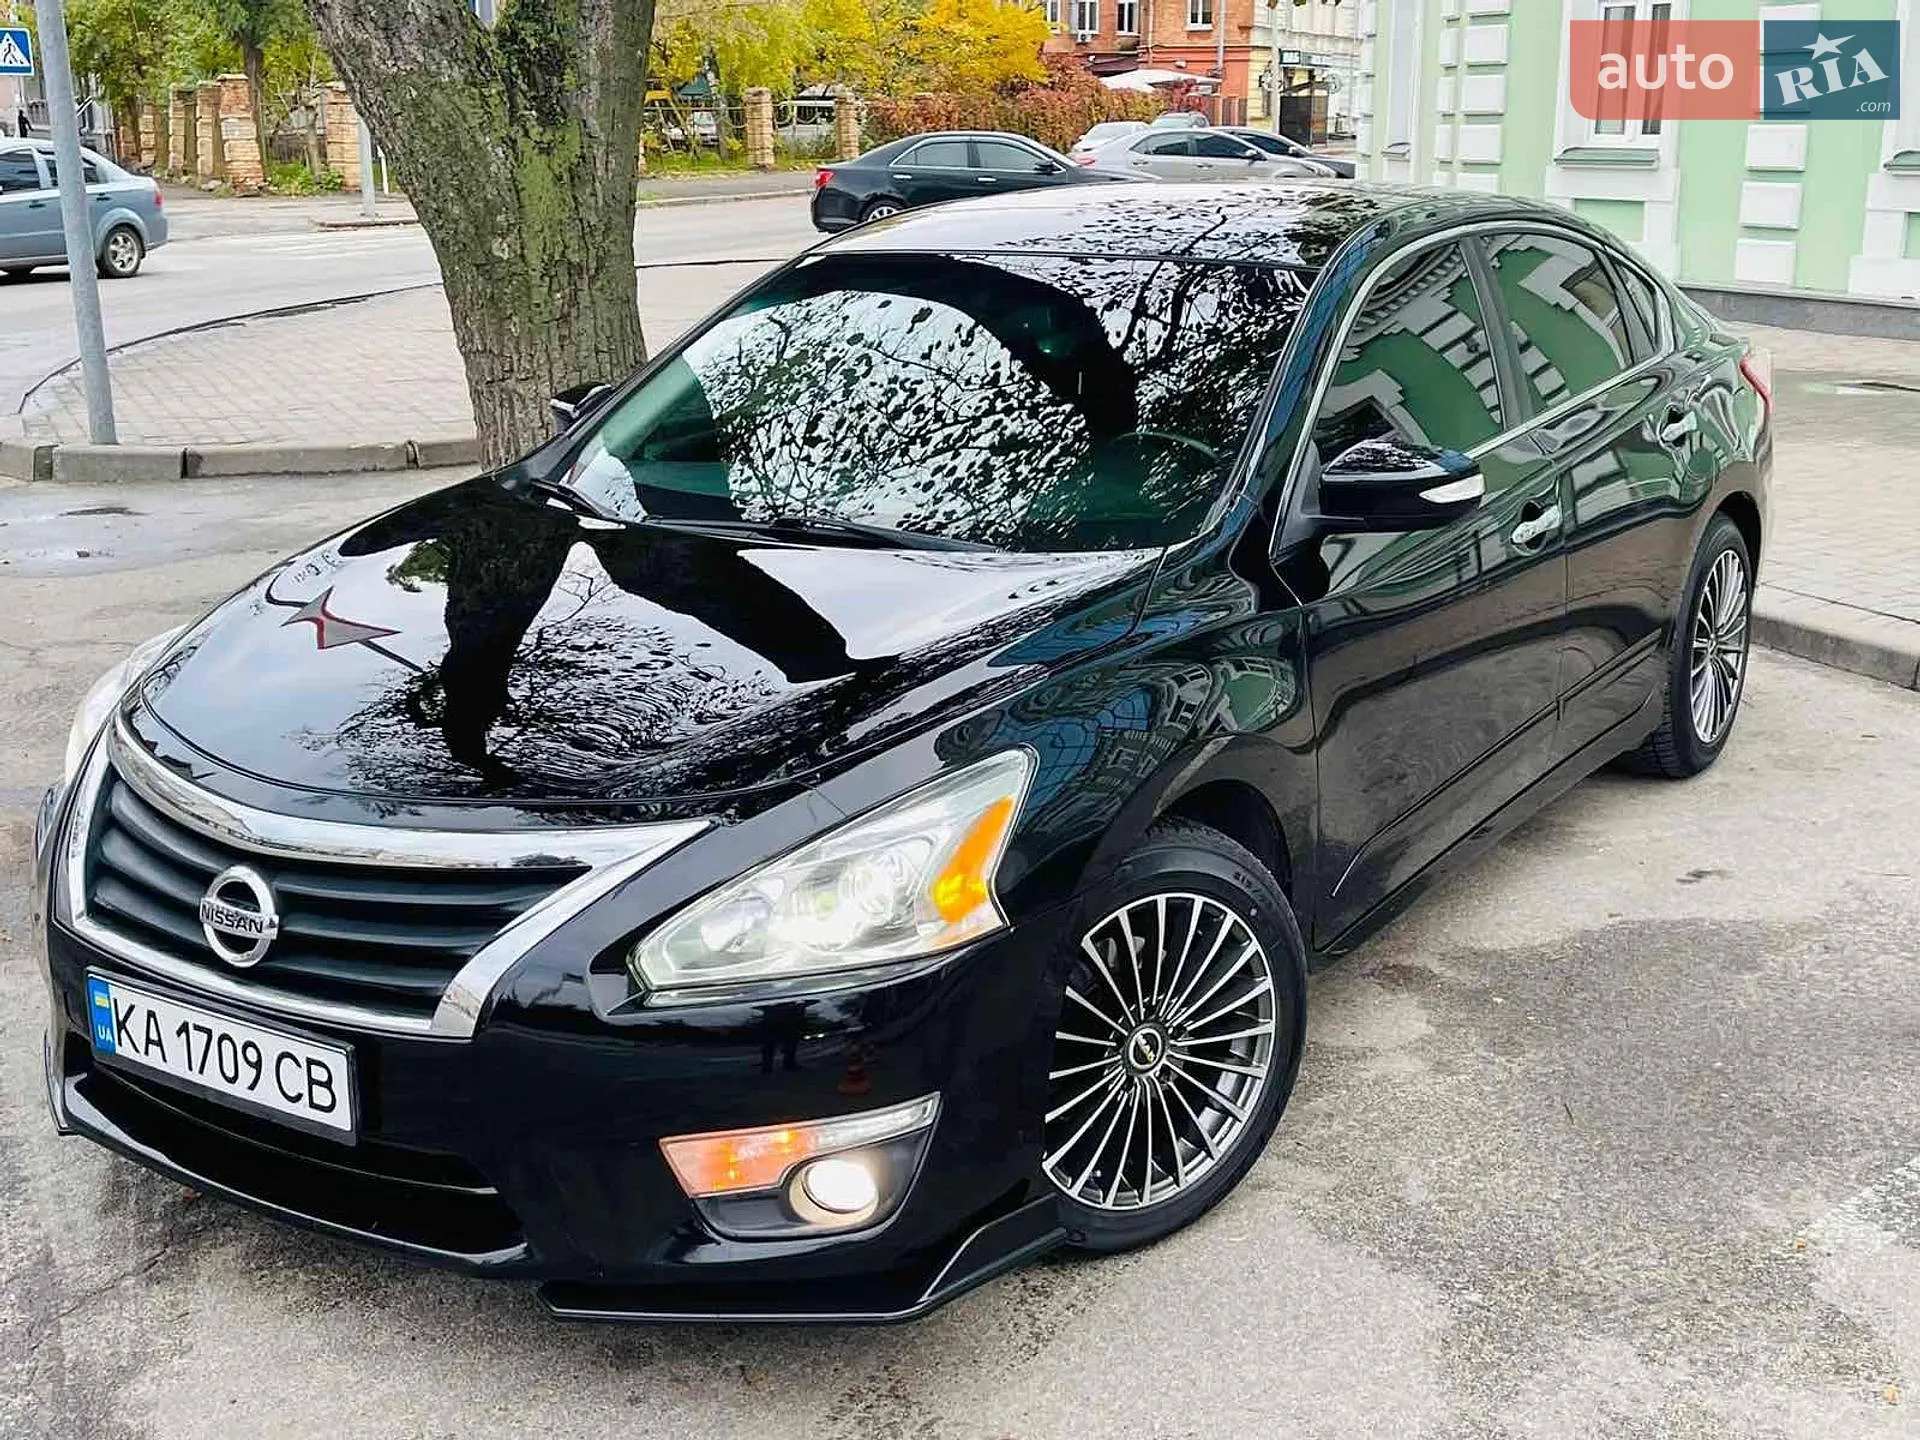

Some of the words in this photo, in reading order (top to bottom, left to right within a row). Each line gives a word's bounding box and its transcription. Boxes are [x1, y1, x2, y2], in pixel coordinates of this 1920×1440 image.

[201, 902, 264, 934] NISSAN
[97, 1023, 113, 1043] UA
[112, 997, 168, 1064] KA
[175, 1020, 263, 1091] 1709
[274, 1050, 337, 1113] CB
